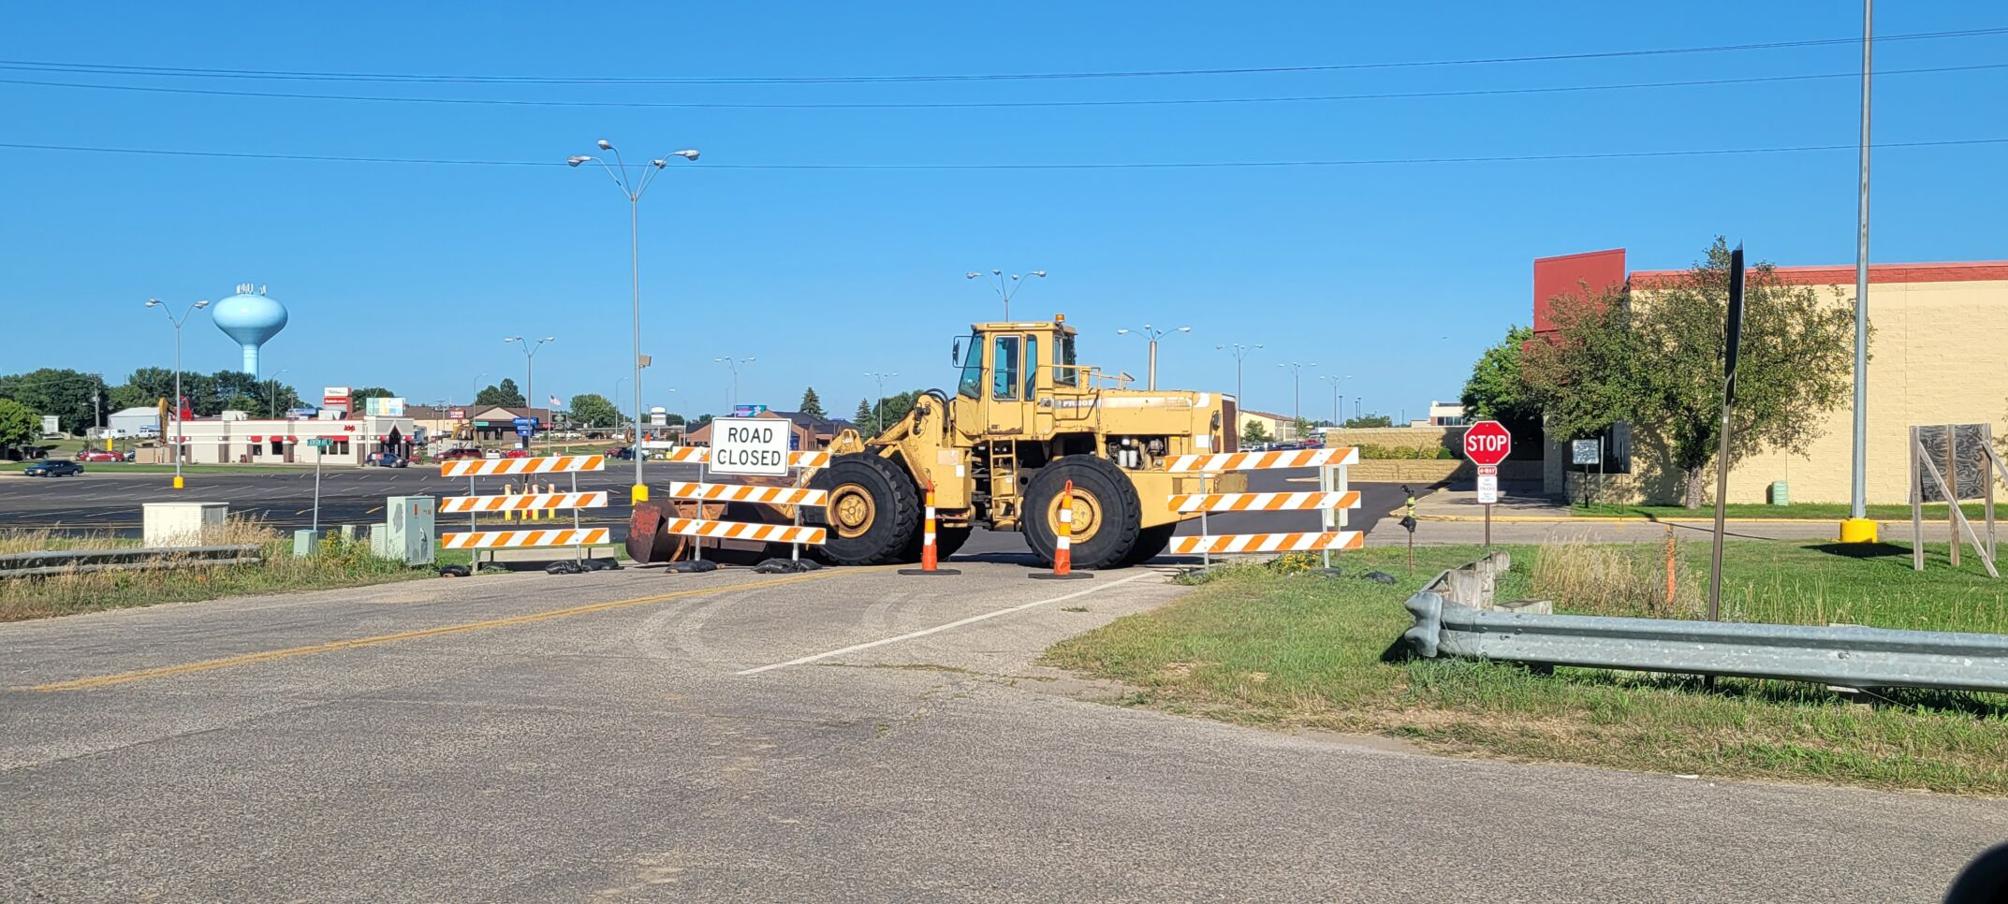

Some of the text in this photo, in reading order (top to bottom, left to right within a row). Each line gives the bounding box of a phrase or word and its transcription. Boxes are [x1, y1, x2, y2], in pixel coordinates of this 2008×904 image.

[728, 427, 773, 443] ROAD
[1467, 435, 1507, 451] STOP
[717, 449, 781, 466] CLOSED
